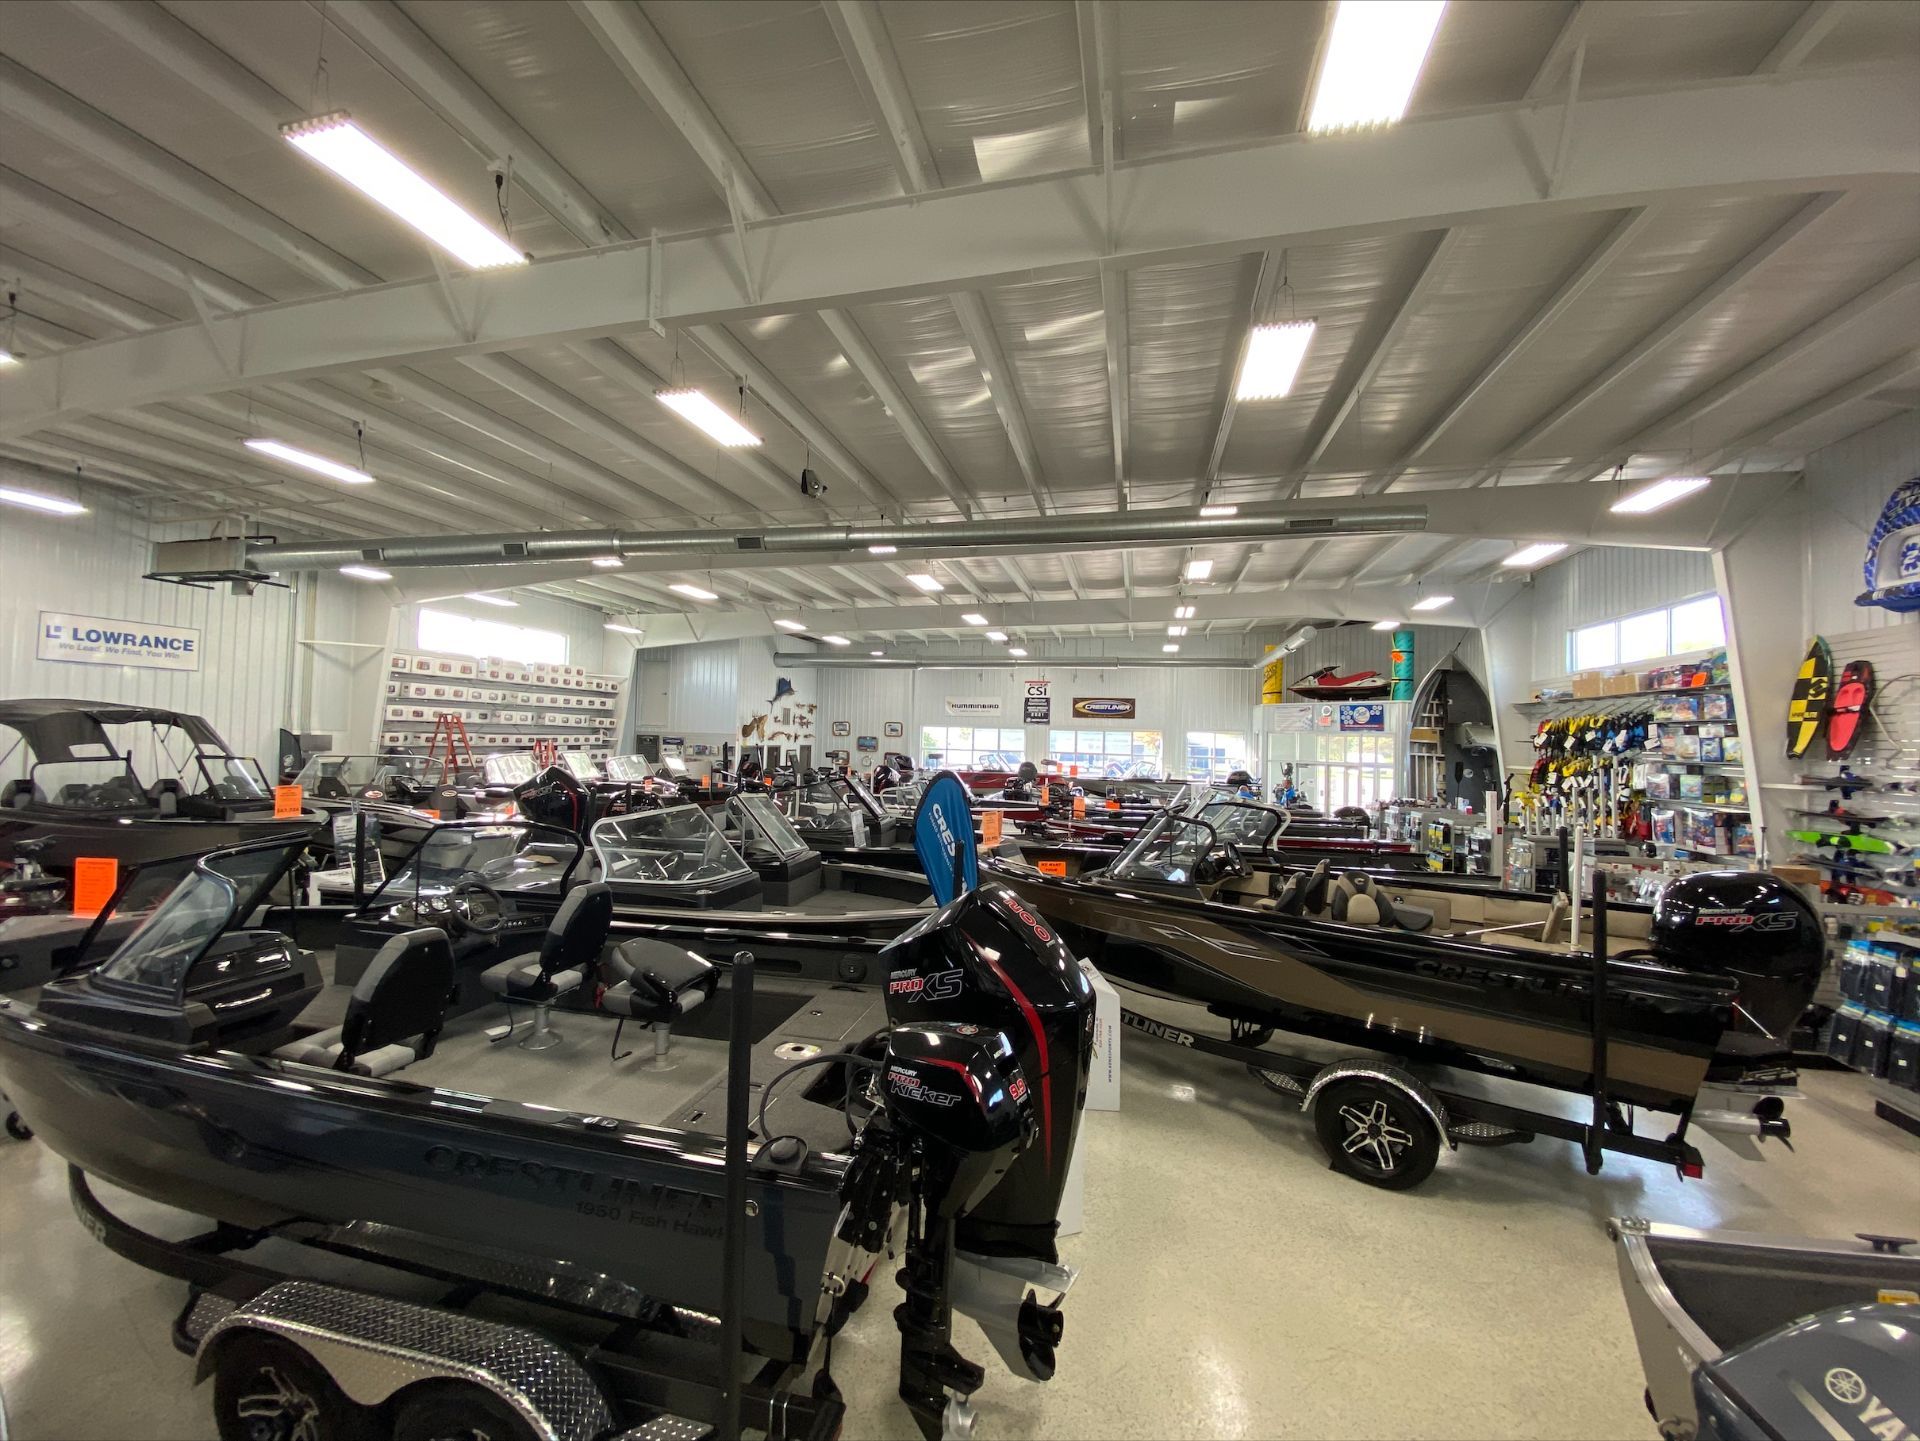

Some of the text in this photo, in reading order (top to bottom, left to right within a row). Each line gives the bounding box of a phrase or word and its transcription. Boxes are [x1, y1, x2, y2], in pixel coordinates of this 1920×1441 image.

[72, 627, 194, 652] LOWRANCE
[105, 646, 119, 654] We
[1003, 897, 1050, 942] 200
[890, 968, 917, 979] MERCURY
[889, 978, 924, 995] PRO
[1121, 1011, 1194, 1048] TLINER
[890, 1065, 918, 1077] MERCURY
[575, 1200, 621, 1220] 1950
[628, 1210, 668, 1230] Fish
[1858, 1395, 1920, 1441] YA
